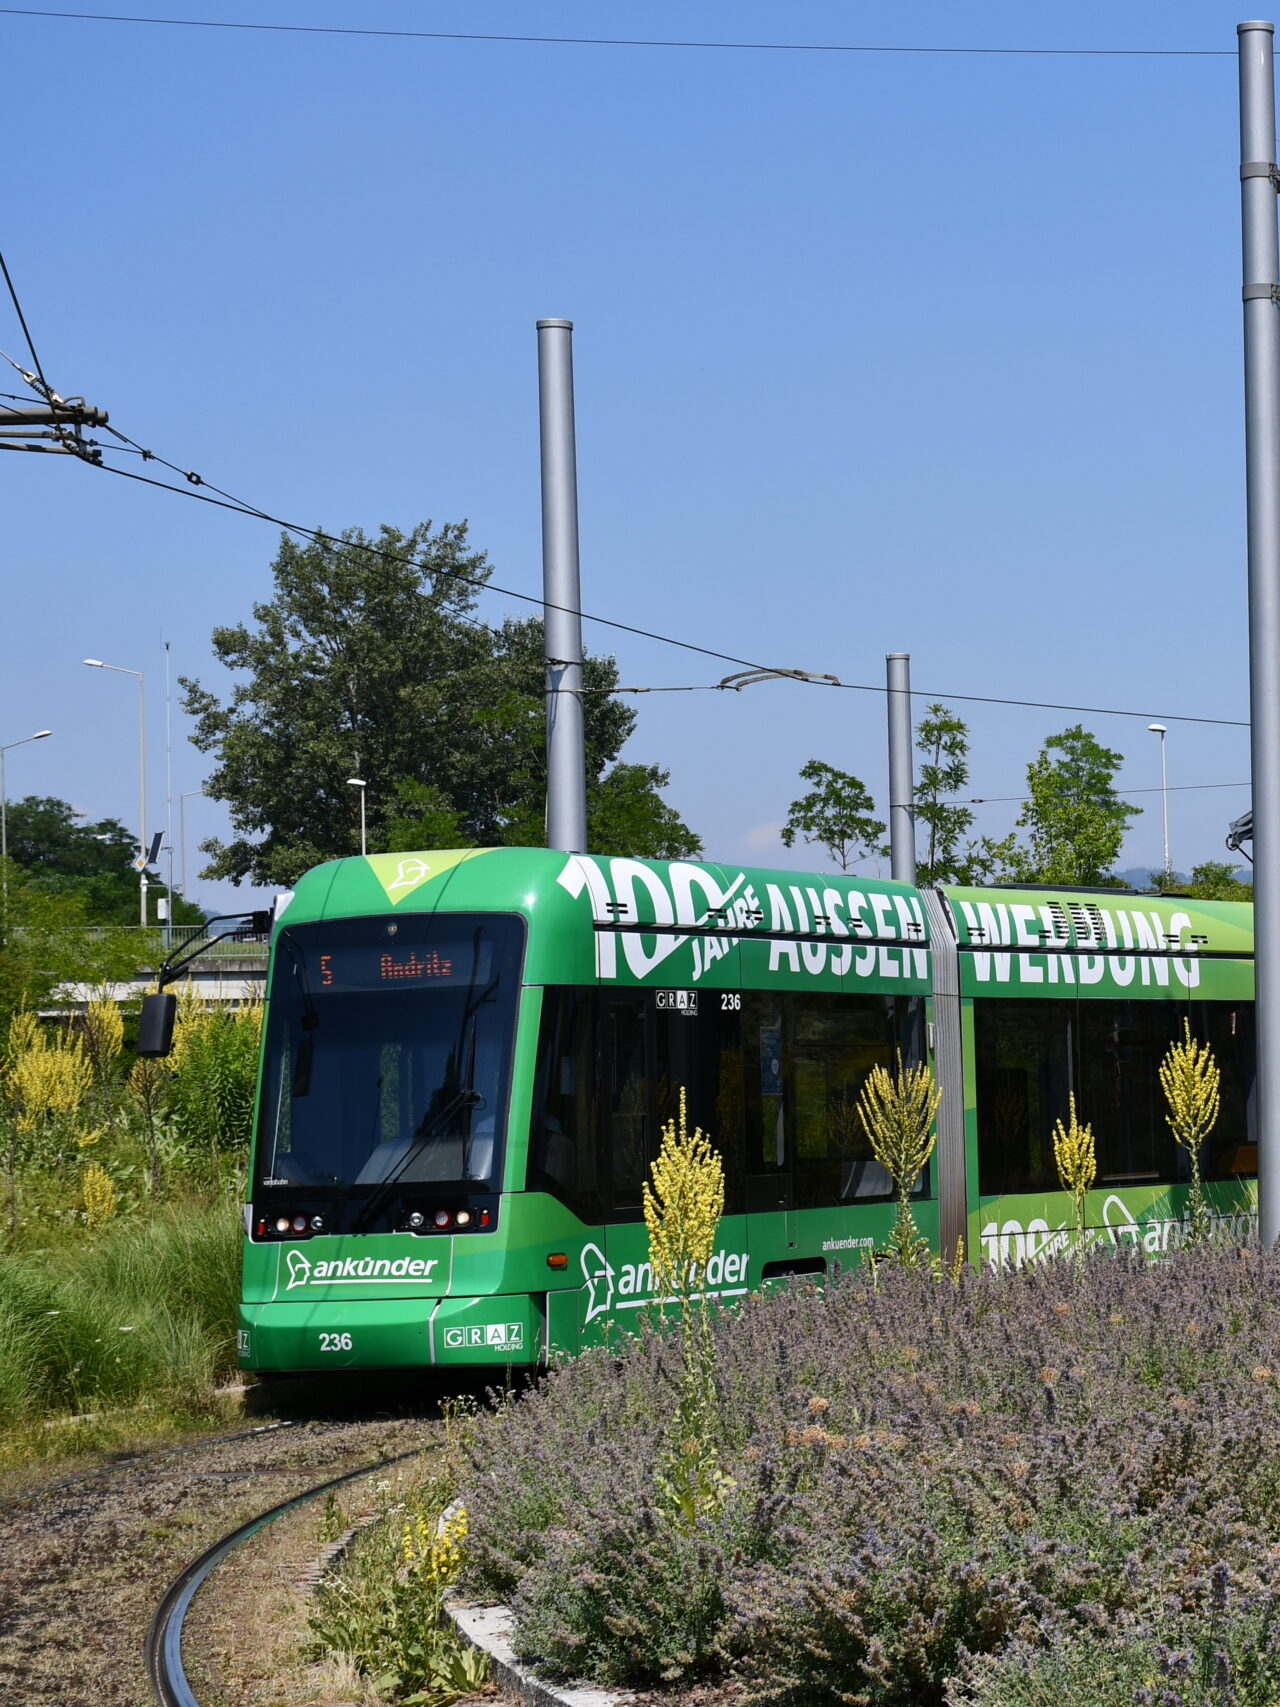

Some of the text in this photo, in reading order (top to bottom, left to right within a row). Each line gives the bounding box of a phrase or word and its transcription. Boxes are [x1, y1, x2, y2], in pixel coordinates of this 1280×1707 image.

[557, 855, 1200, 988] 100 JAHRE AUSSEN WERBUNG
[320, 950, 453, 985] 5 Andritz
[656, 990, 698, 1009] GRAZ
[721, 993, 741, 1010] 236
[822, 1235, 875, 1251] ankuender.com
[313, 1256, 439, 1278] ankünder
[318, 1332, 353, 1352] 236
[444, 1322, 524, 1349] GRAZ
[494, 1342, 524, 1352] HOLDING
